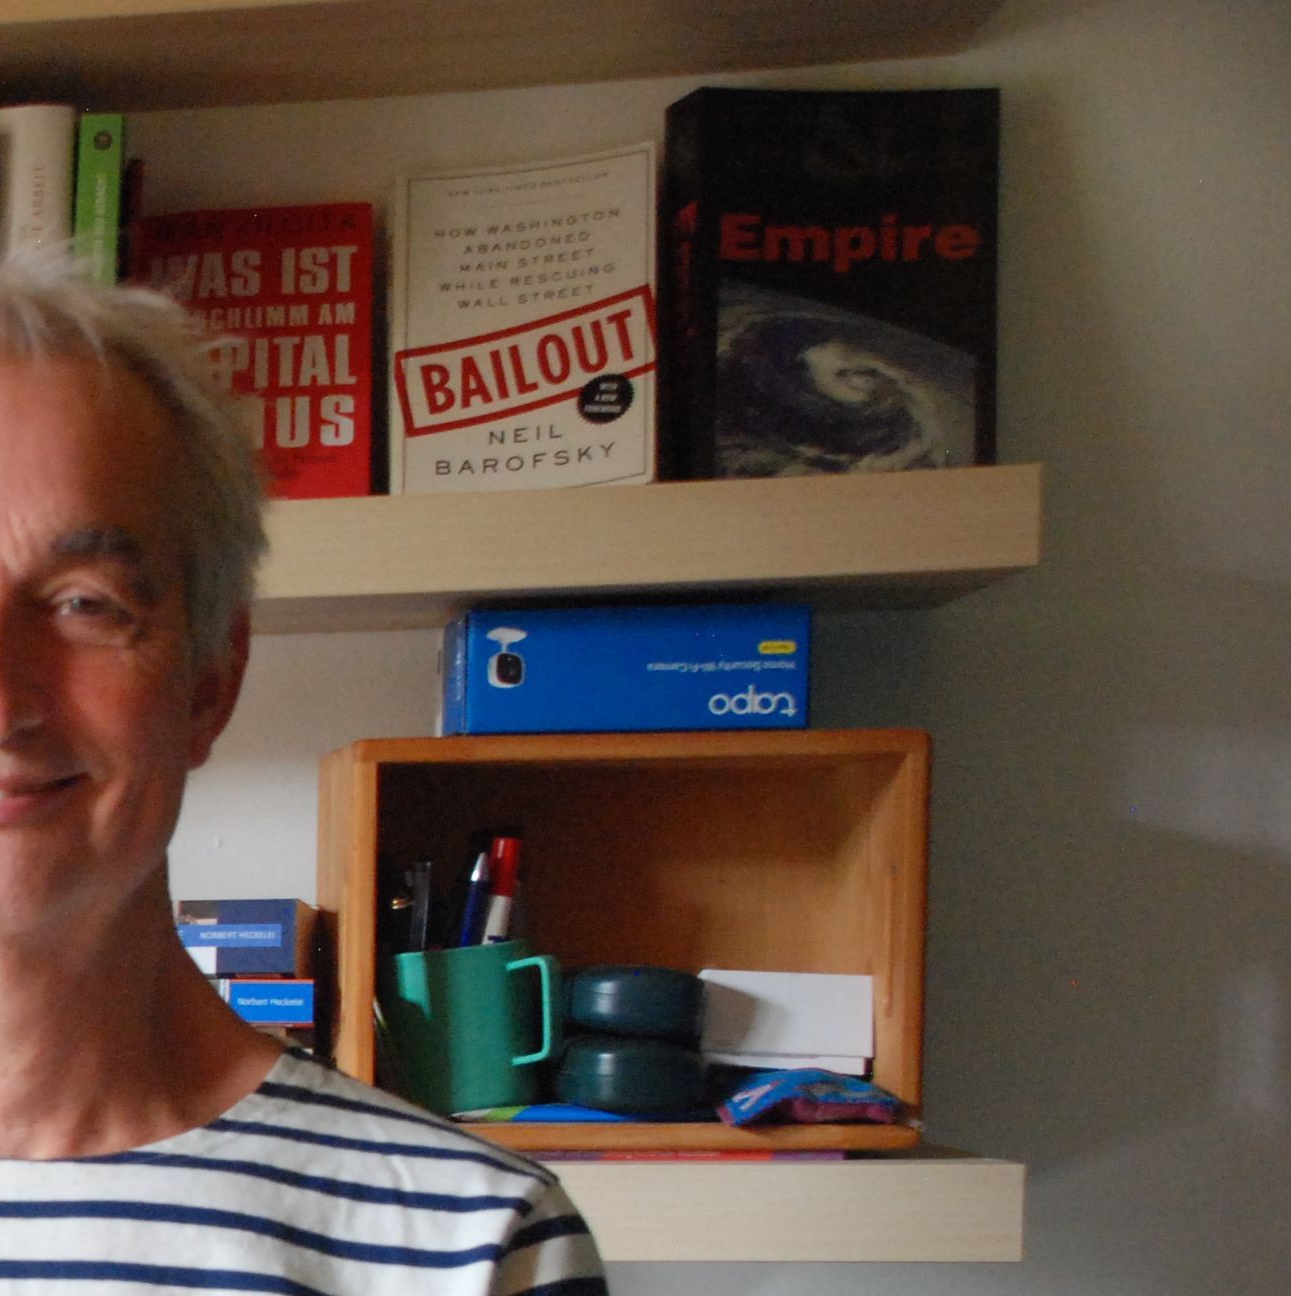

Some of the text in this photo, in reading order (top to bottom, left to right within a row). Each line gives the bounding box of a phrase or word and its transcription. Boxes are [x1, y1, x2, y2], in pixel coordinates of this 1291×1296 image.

[434, 209, 621, 238] HOW WASHINGTON
[464, 231, 591, 254] ABANDONED
[718, 212, 980, 273] Empire
[281, 246, 357, 295] IST
[459, 248, 595, 273] MAIN STREET
[440, 264, 616, 292] WHILE RESCUING
[457, 285, 595, 309] WALL STREET
[199, 302, 355, 331] CHLIMM AM
[420, 309, 635, 415] BAILOUT
[488, 424, 564, 445] NEIL
[436, 442, 616, 476] BAROFSKY
[708, 684, 796, 717] tapo
